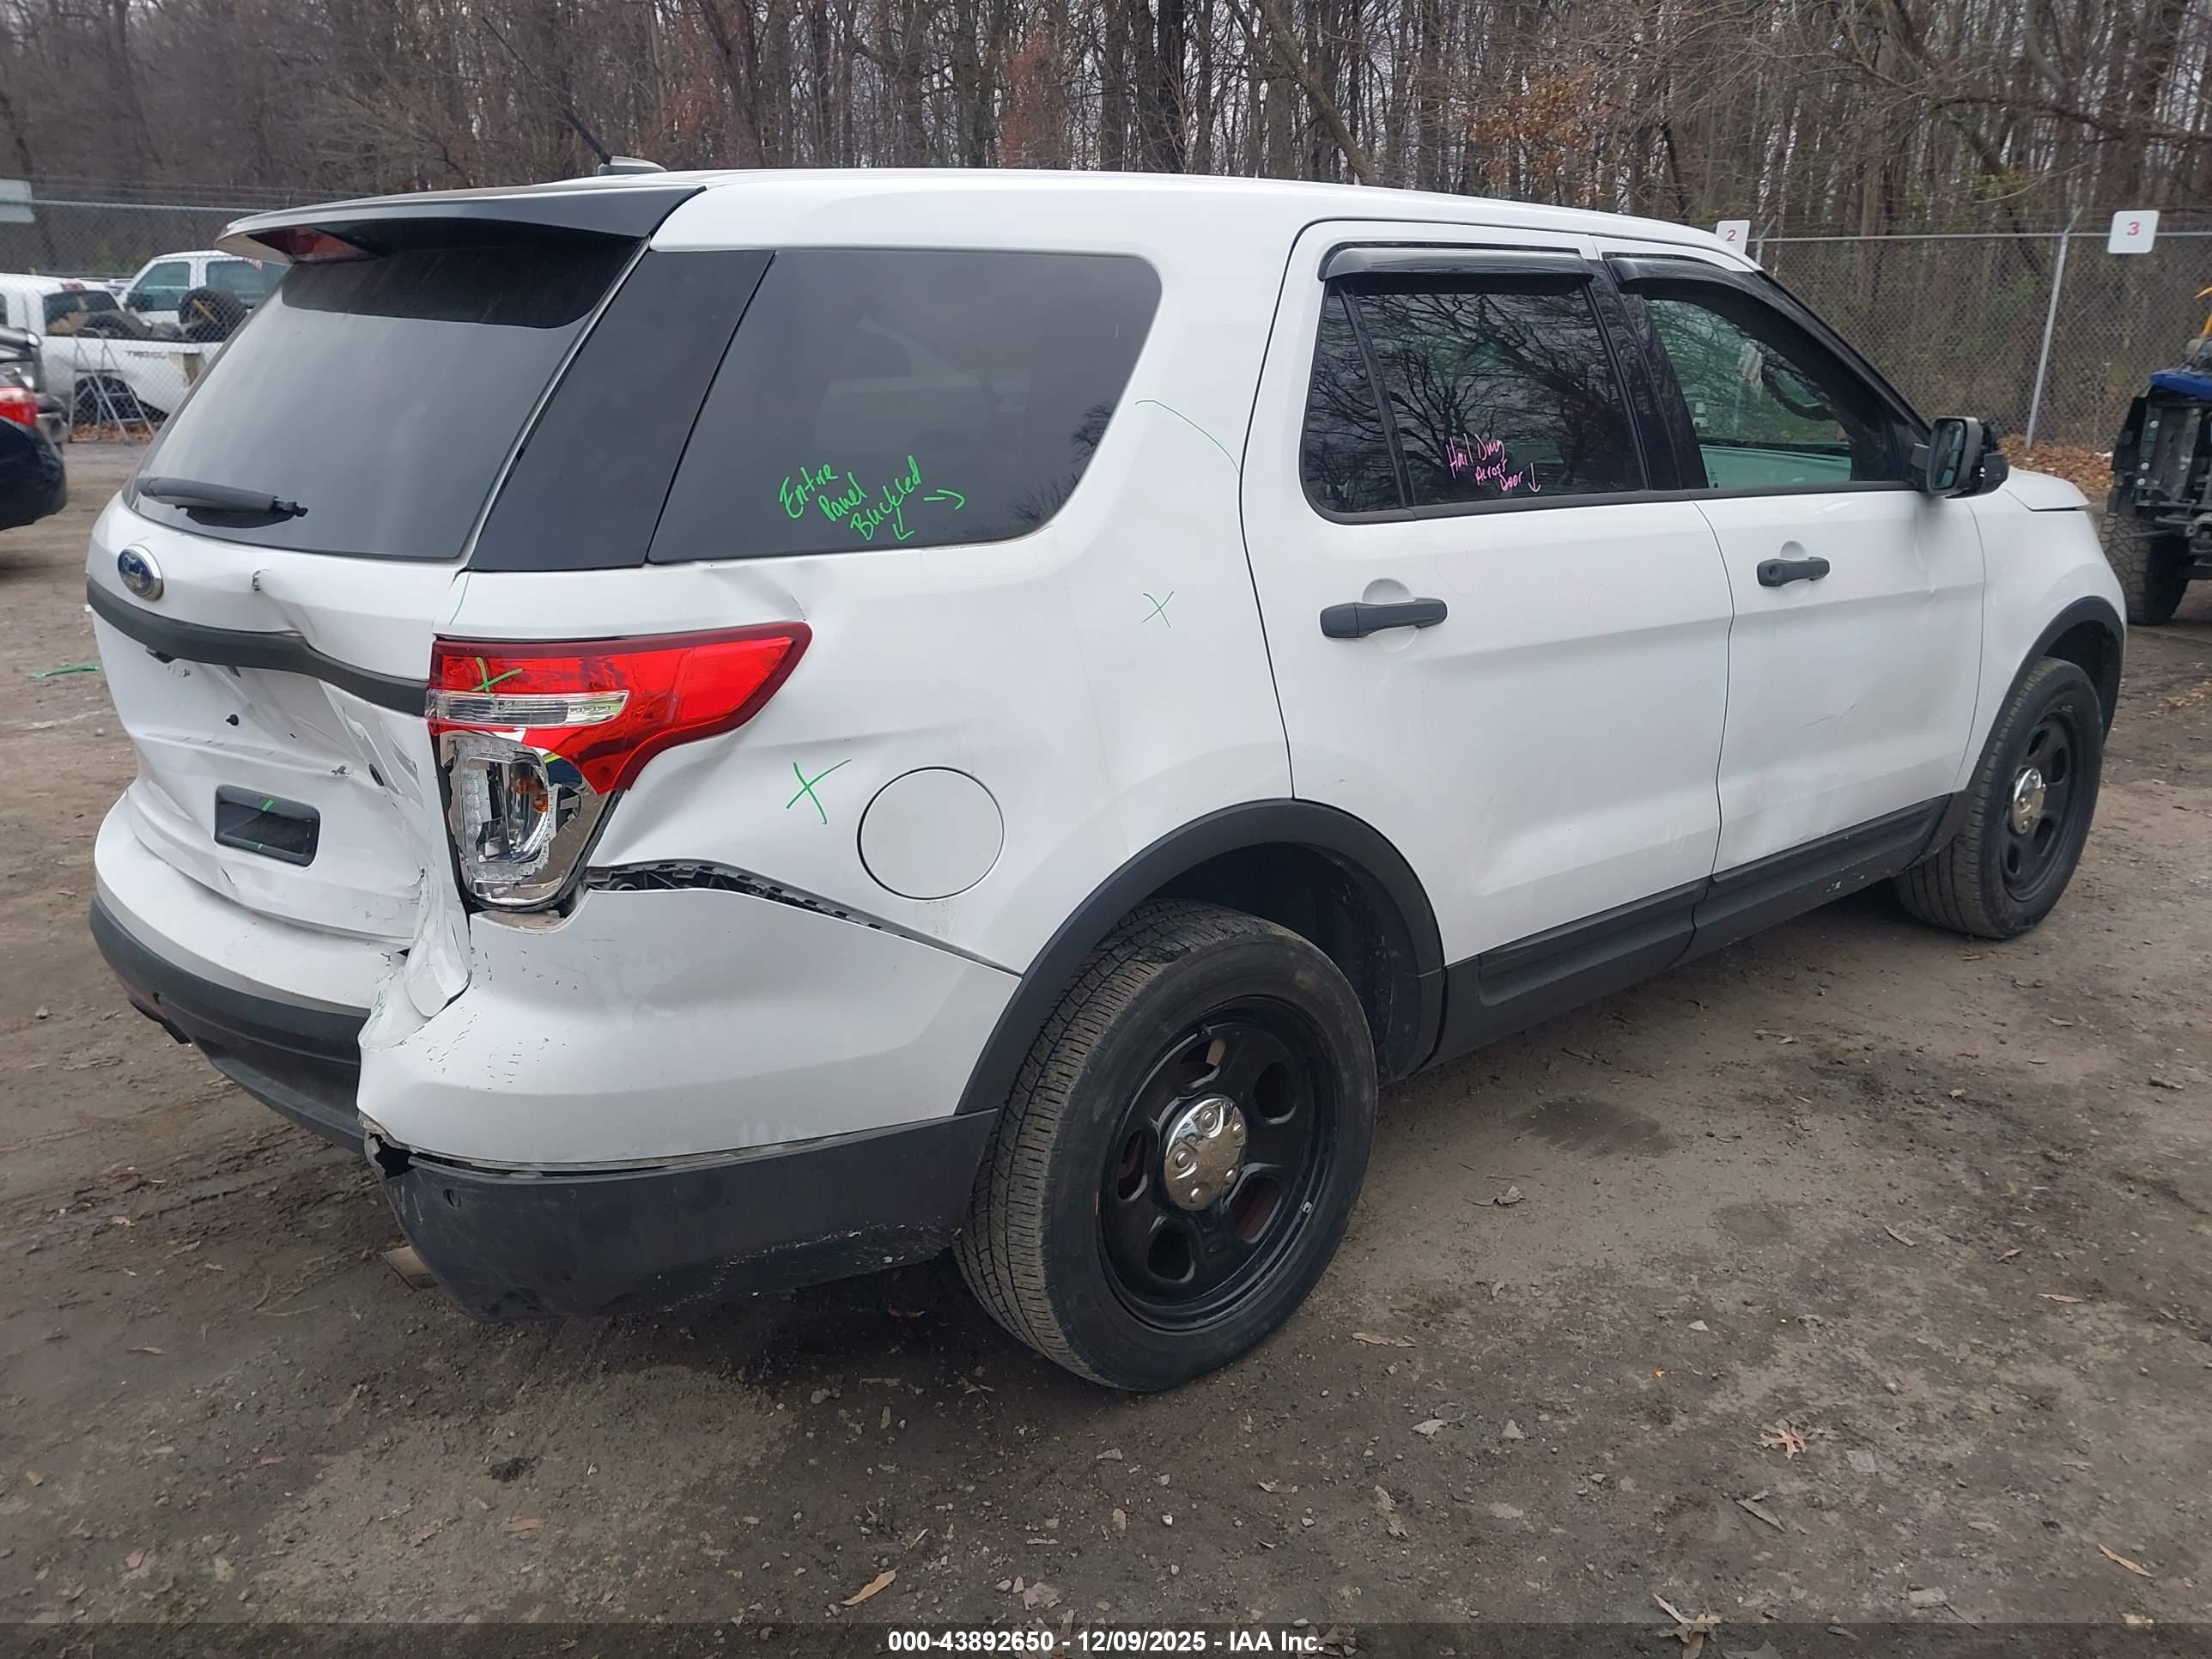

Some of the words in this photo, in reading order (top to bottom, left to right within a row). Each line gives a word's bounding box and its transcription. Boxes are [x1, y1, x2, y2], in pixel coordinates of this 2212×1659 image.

[1726, 228, 1736, 242] 2
[2127, 221, 2140, 236] 3
[1445, 432, 1474, 479] Hail
[779, 464, 839, 519] Entire
[818, 471, 867, 522] Panel
[850, 455, 921, 541] Buckled
[1499, 471, 1523, 492] Door
